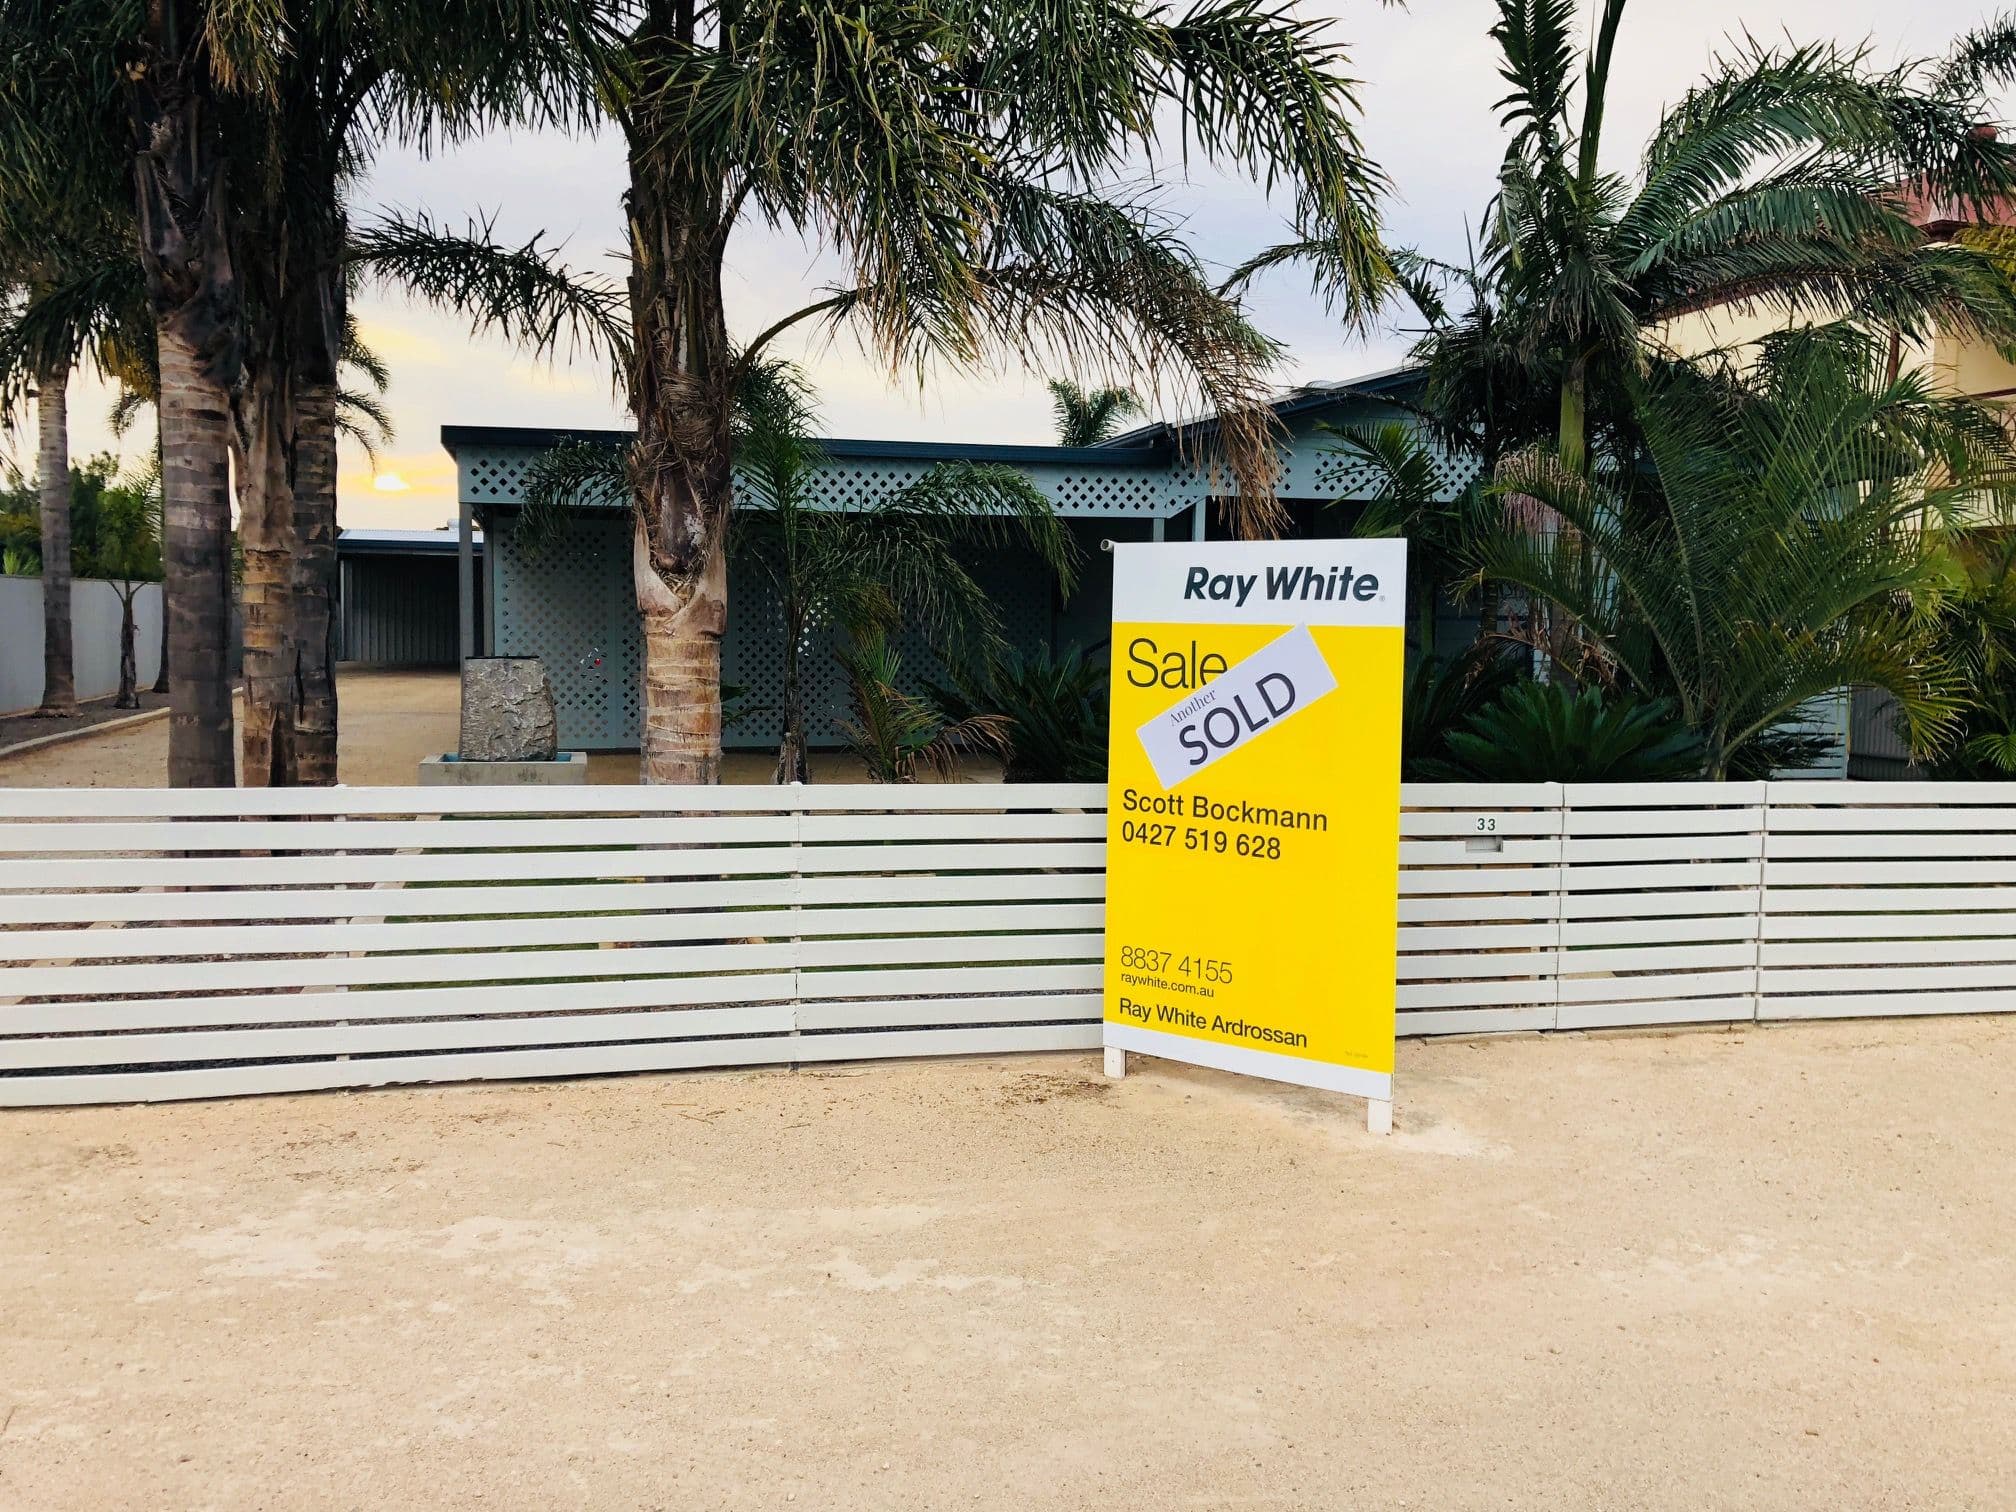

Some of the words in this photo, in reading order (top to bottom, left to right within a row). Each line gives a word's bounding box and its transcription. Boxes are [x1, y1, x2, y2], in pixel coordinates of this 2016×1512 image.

[1184, 566, 1257, 607] Ray
[1265, 566, 1379, 601] White
[1127, 638, 1228, 689] Sale
[1170, 689, 1217, 726] Another
[1179, 672, 1296, 765] SOLD
[1123, 789, 1184, 816] Scott
[1192, 796, 1328, 831] Bockmann
[1477, 818, 1496, 831] 33
[1122, 821, 1176, 847] 0427
[1185, 828, 1227, 853] 519
[1236, 834, 1281, 860] 628
[1121, 945, 1172, 973] 8837
[1178, 956, 1233, 984] 4155
[1121, 973, 1214, 998] raywhite.com.au
[1119, 998, 1151, 1023] Ray
[1156, 1004, 1206, 1029] White
[1211, 1015, 1307, 1048] Ardrossan
